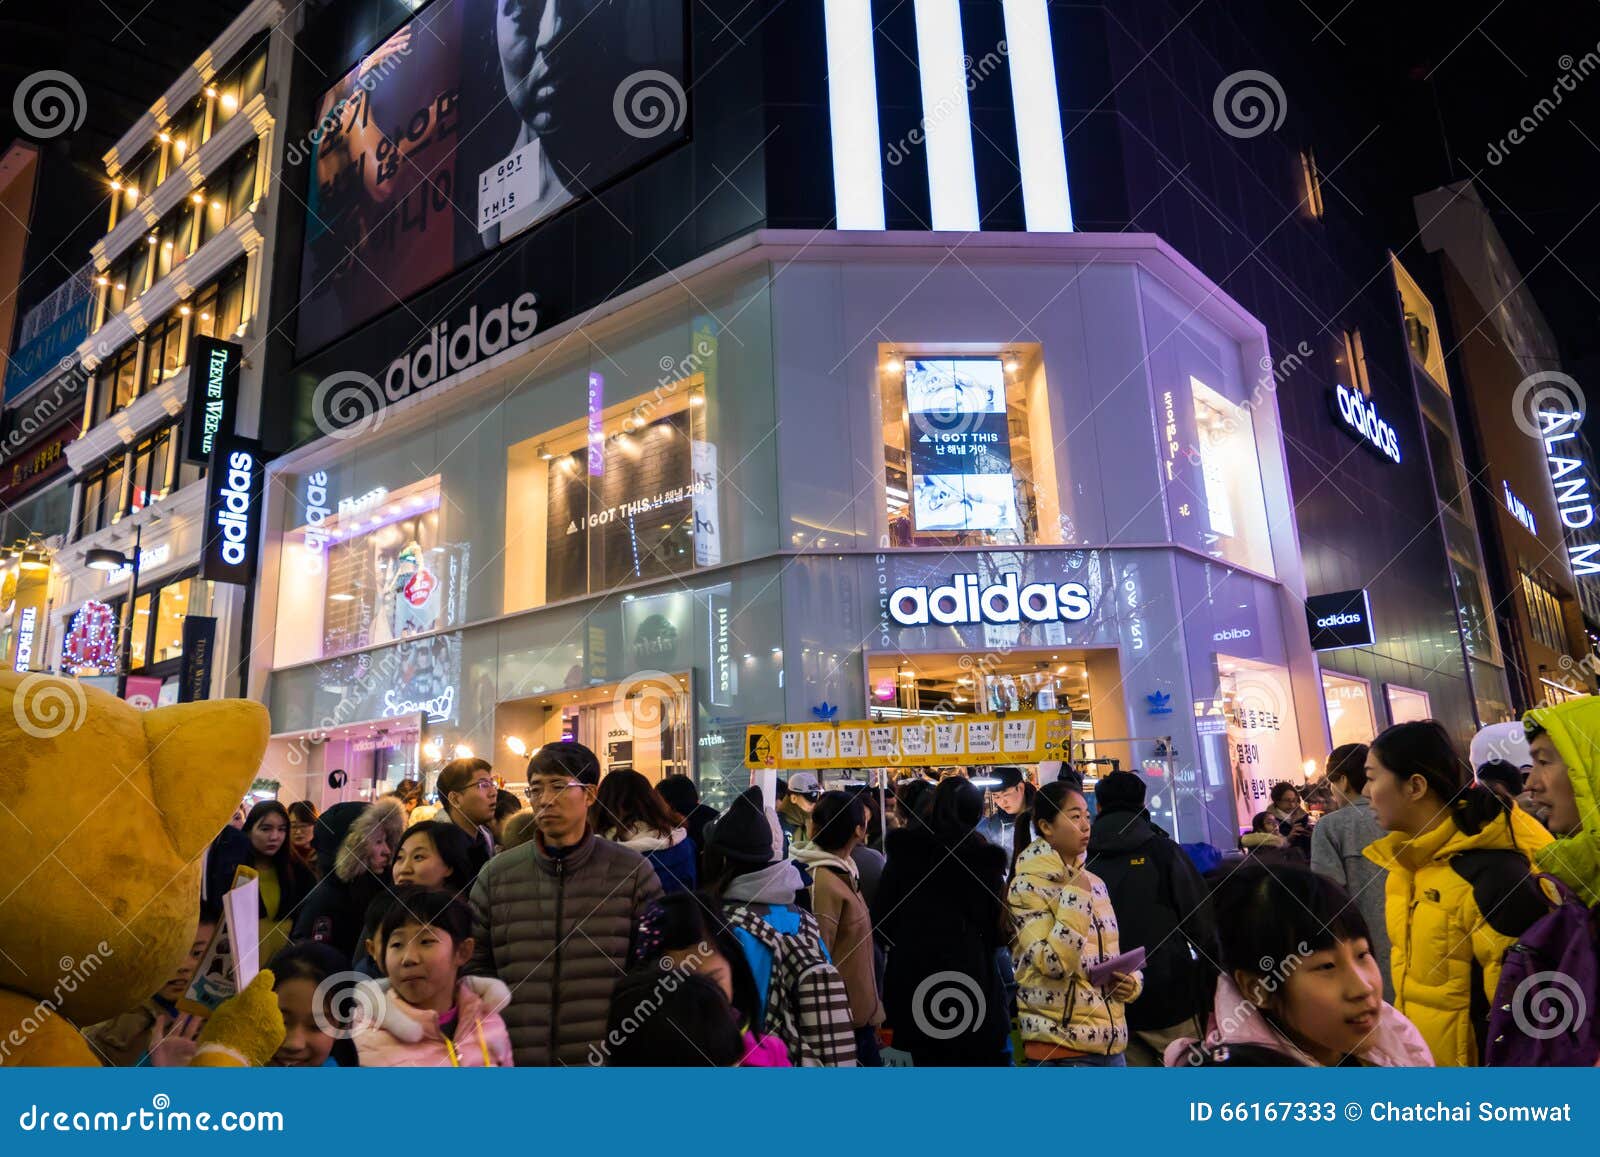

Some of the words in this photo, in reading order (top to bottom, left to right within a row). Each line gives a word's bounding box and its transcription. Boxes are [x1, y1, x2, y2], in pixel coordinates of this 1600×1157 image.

[496, 155, 524, 178] GOT
[482, 191, 516, 218] THIS
[384, 292, 539, 402] adidas
[207, 349, 228, 399] TEENIE
[941, 433, 968, 443] GOT
[971, 432, 998, 443] THIS
[1336, 384, 1401, 464] adidas
[968, 444, 987, 455] 거야
[217, 451, 252, 566] adidas
[589, 508, 616, 528] GOT
[889, 572, 1092, 627] adidas
[1316, 612, 1361, 627] adidas
